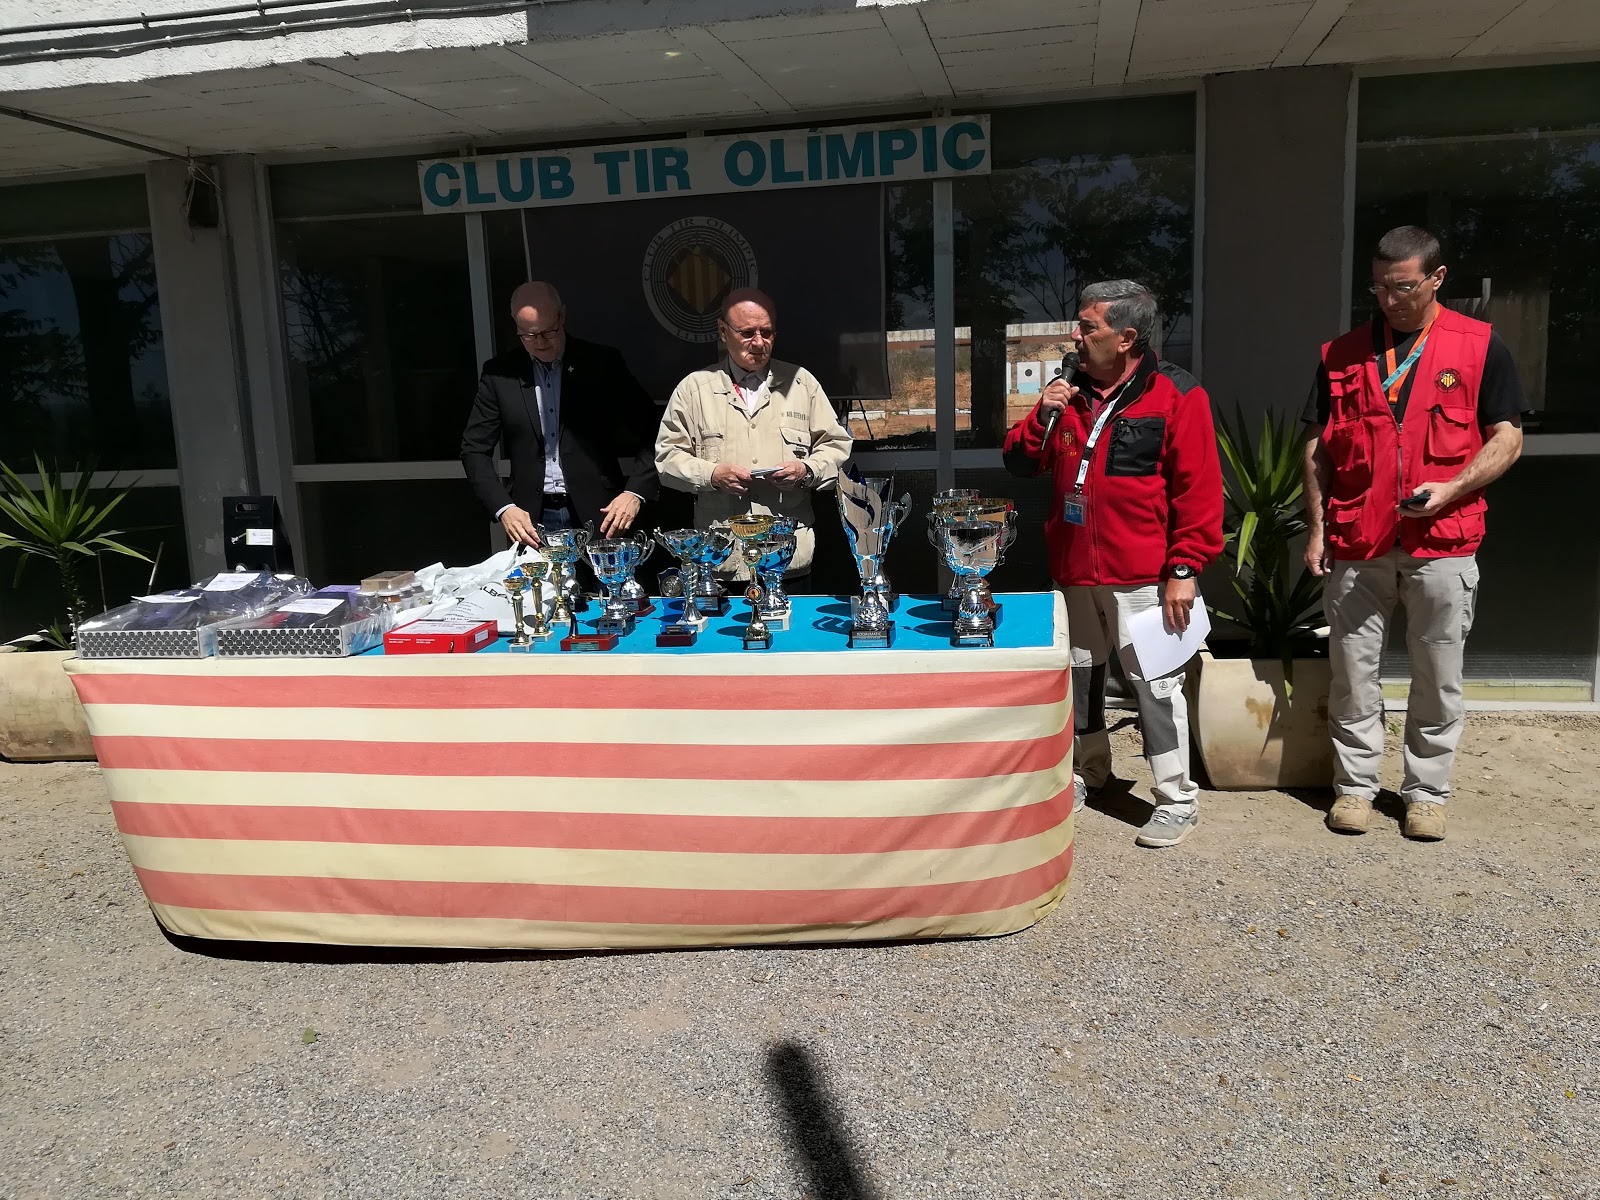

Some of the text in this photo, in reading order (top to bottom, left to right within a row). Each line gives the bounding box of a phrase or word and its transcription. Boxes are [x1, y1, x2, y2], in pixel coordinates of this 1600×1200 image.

[423, 121, 986, 207] CLUB TIR OLÍMPIC
[643, 217, 758, 281] CLUB TIR OLIMPIC
[676, 328, 720, 343] LLEID
